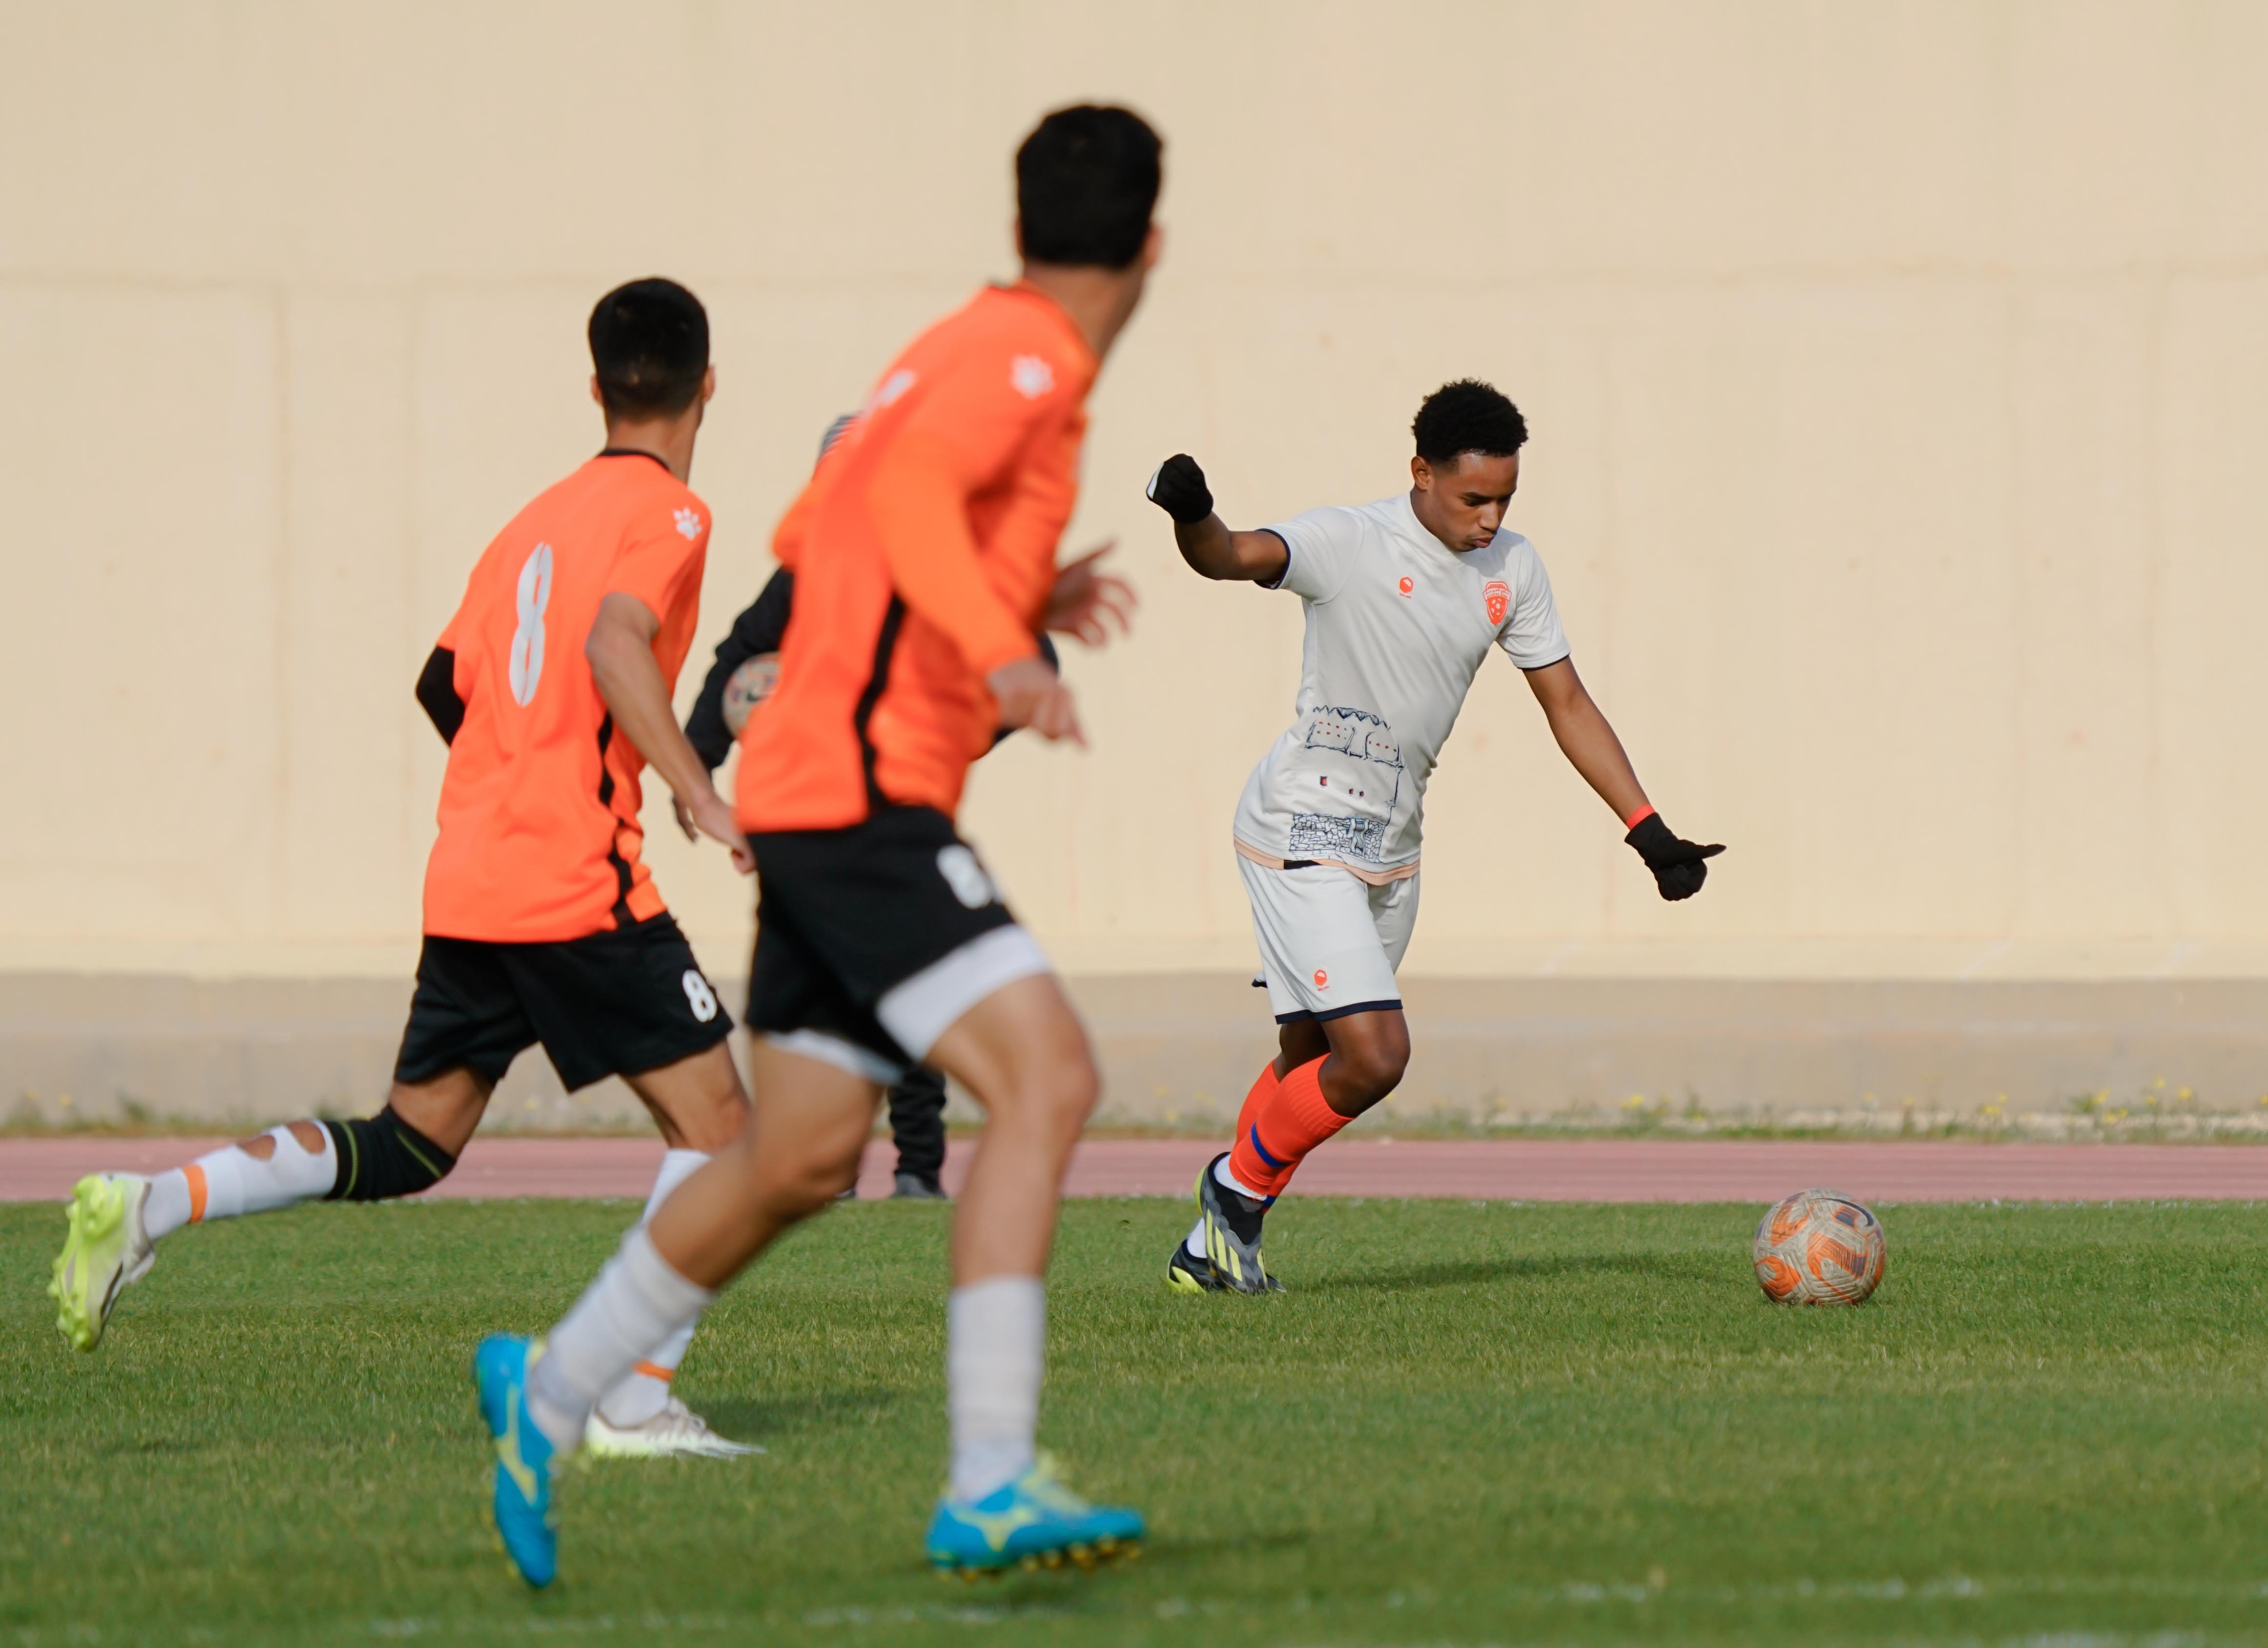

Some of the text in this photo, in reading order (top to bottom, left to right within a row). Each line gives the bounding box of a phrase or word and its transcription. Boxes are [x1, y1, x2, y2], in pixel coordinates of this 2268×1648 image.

[509, 541, 553, 707] 8
[936, 844, 1003, 909] 8
[682, 969, 717, 1023] 8
